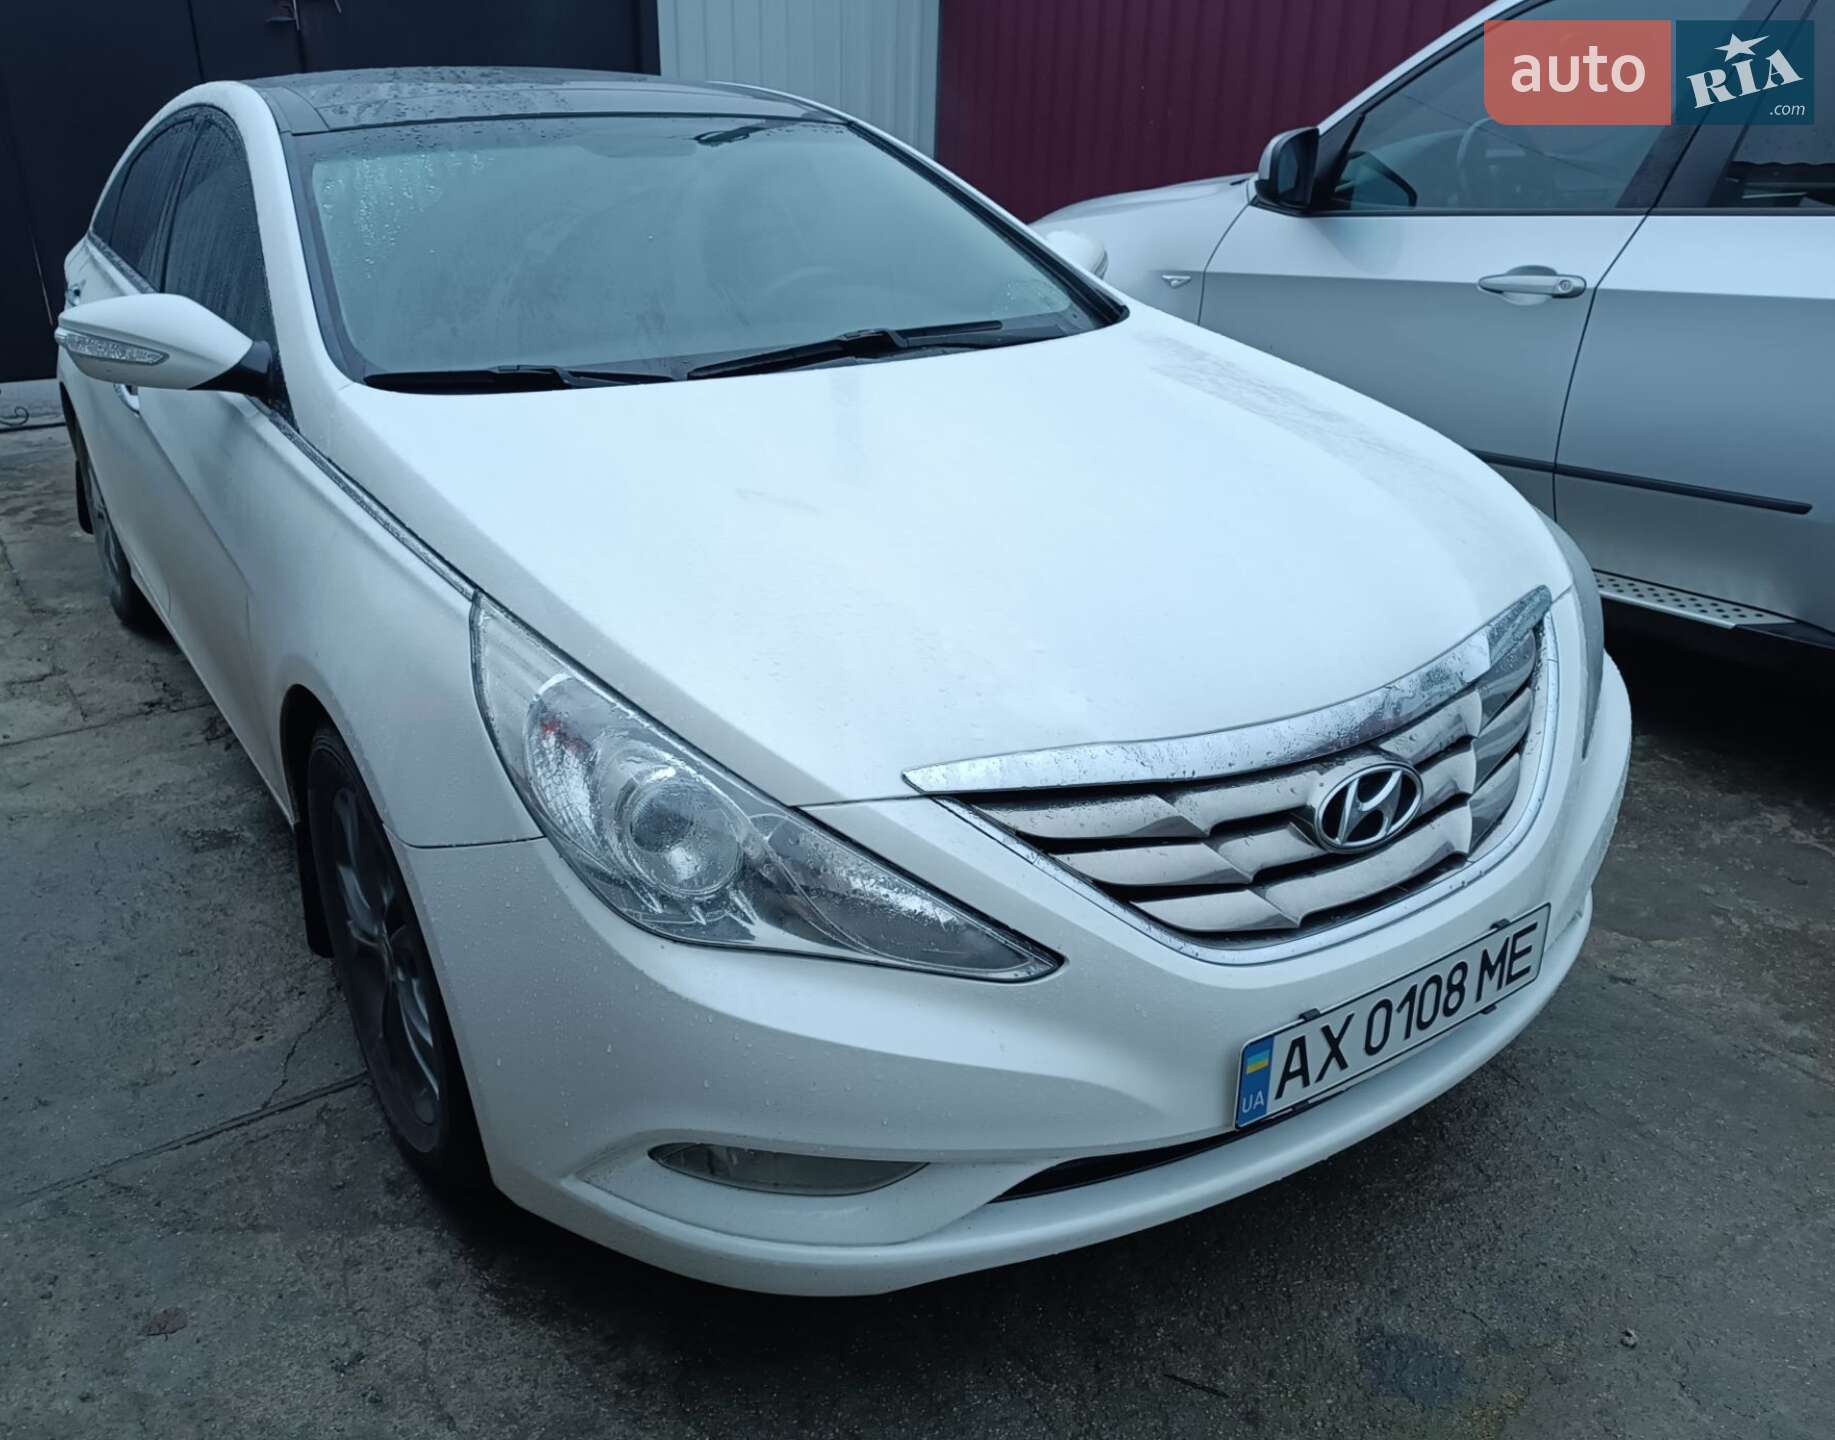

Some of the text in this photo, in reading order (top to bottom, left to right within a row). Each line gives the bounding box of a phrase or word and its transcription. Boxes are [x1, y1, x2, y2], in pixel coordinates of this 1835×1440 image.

[1274, 921, 1538, 1101] AX 0108 ME
[1241, 1090, 1265, 1113] UA
